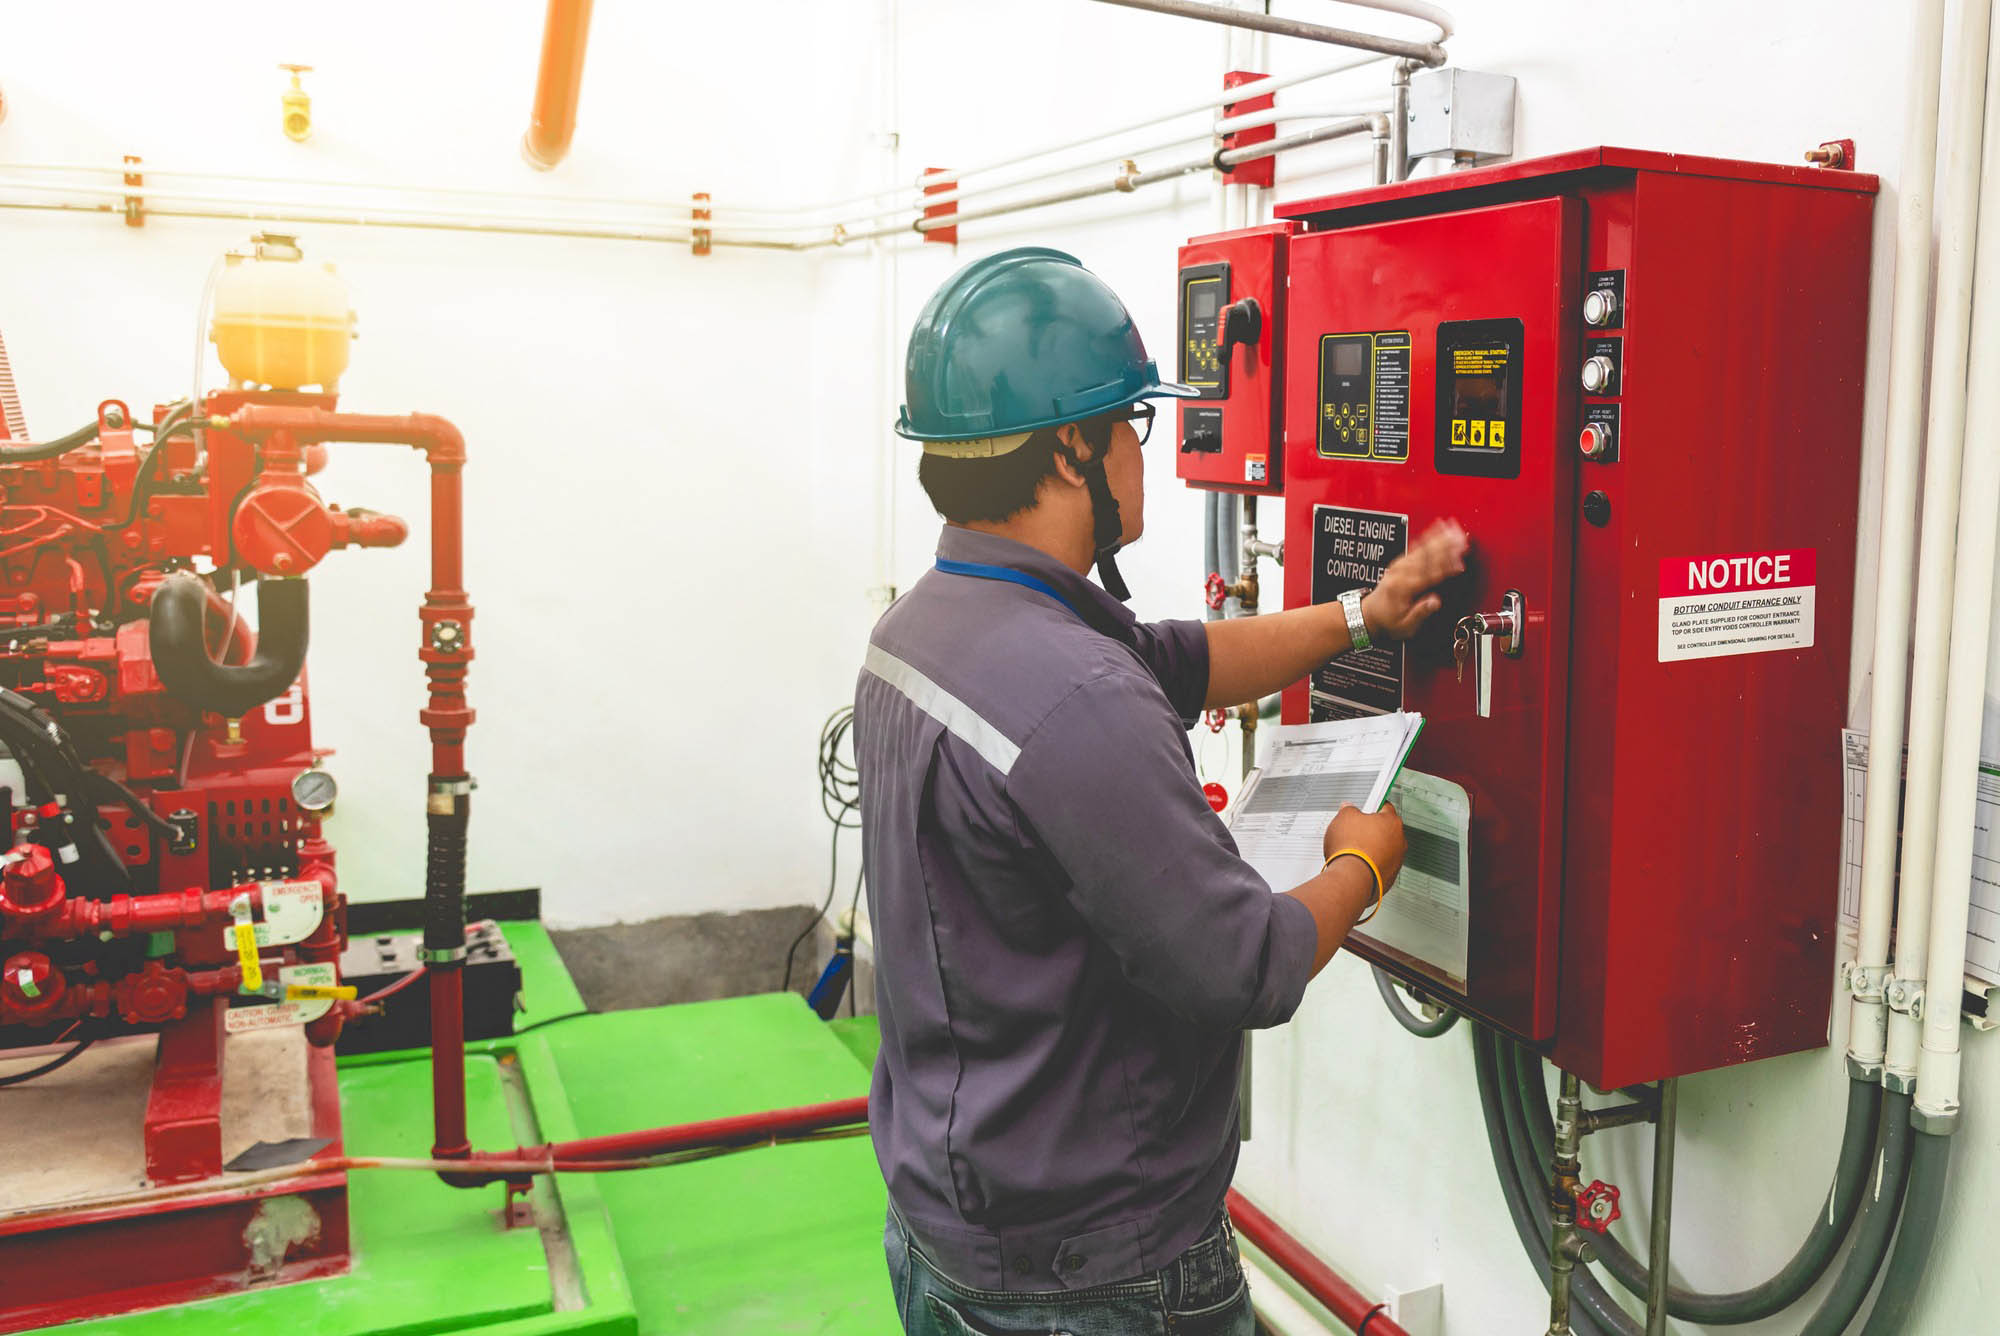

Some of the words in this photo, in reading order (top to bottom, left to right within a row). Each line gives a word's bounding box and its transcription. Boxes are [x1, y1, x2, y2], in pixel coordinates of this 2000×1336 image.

[1324, 516, 1356, 536] DIESEL
[1358, 520, 1396, 541] ENGINE
[1333, 538, 1355, 558] FIRE
[1356, 541, 1385, 562] PUMP
[1688, 554, 1791, 591] NOTICE
[1673, 604, 1706, 615] BOTTOM
[1708, 601, 1740, 612] CONDUIT
[1742, 597, 1781, 609] ENTRANCE
[1782, 595, 1802, 605] ONLY
[1672, 620, 1691, 628] GLAND
[1692, 618, 1709, 626] PLATE
[1710, 616, 1736, 624] SUPPLIED
[1749, 613, 1771, 621] CONDUIT
[1773, 610, 1800, 618] ENTRANCE
[1692, 627, 1705, 635] SIDE
[1705, 625, 1722, 633] ENTRY
[1739, 621, 1772, 631] CONTROLLER
[1773, 617, 1801, 626] WARRANTY
[1687, 640, 1717, 649] CONTROLLER
[1717, 638, 1746, 646] DIMENSIONAL
[1747, 635, 1767, 643] DRAWING
[272, 884, 320, 896] EMERGENCY
